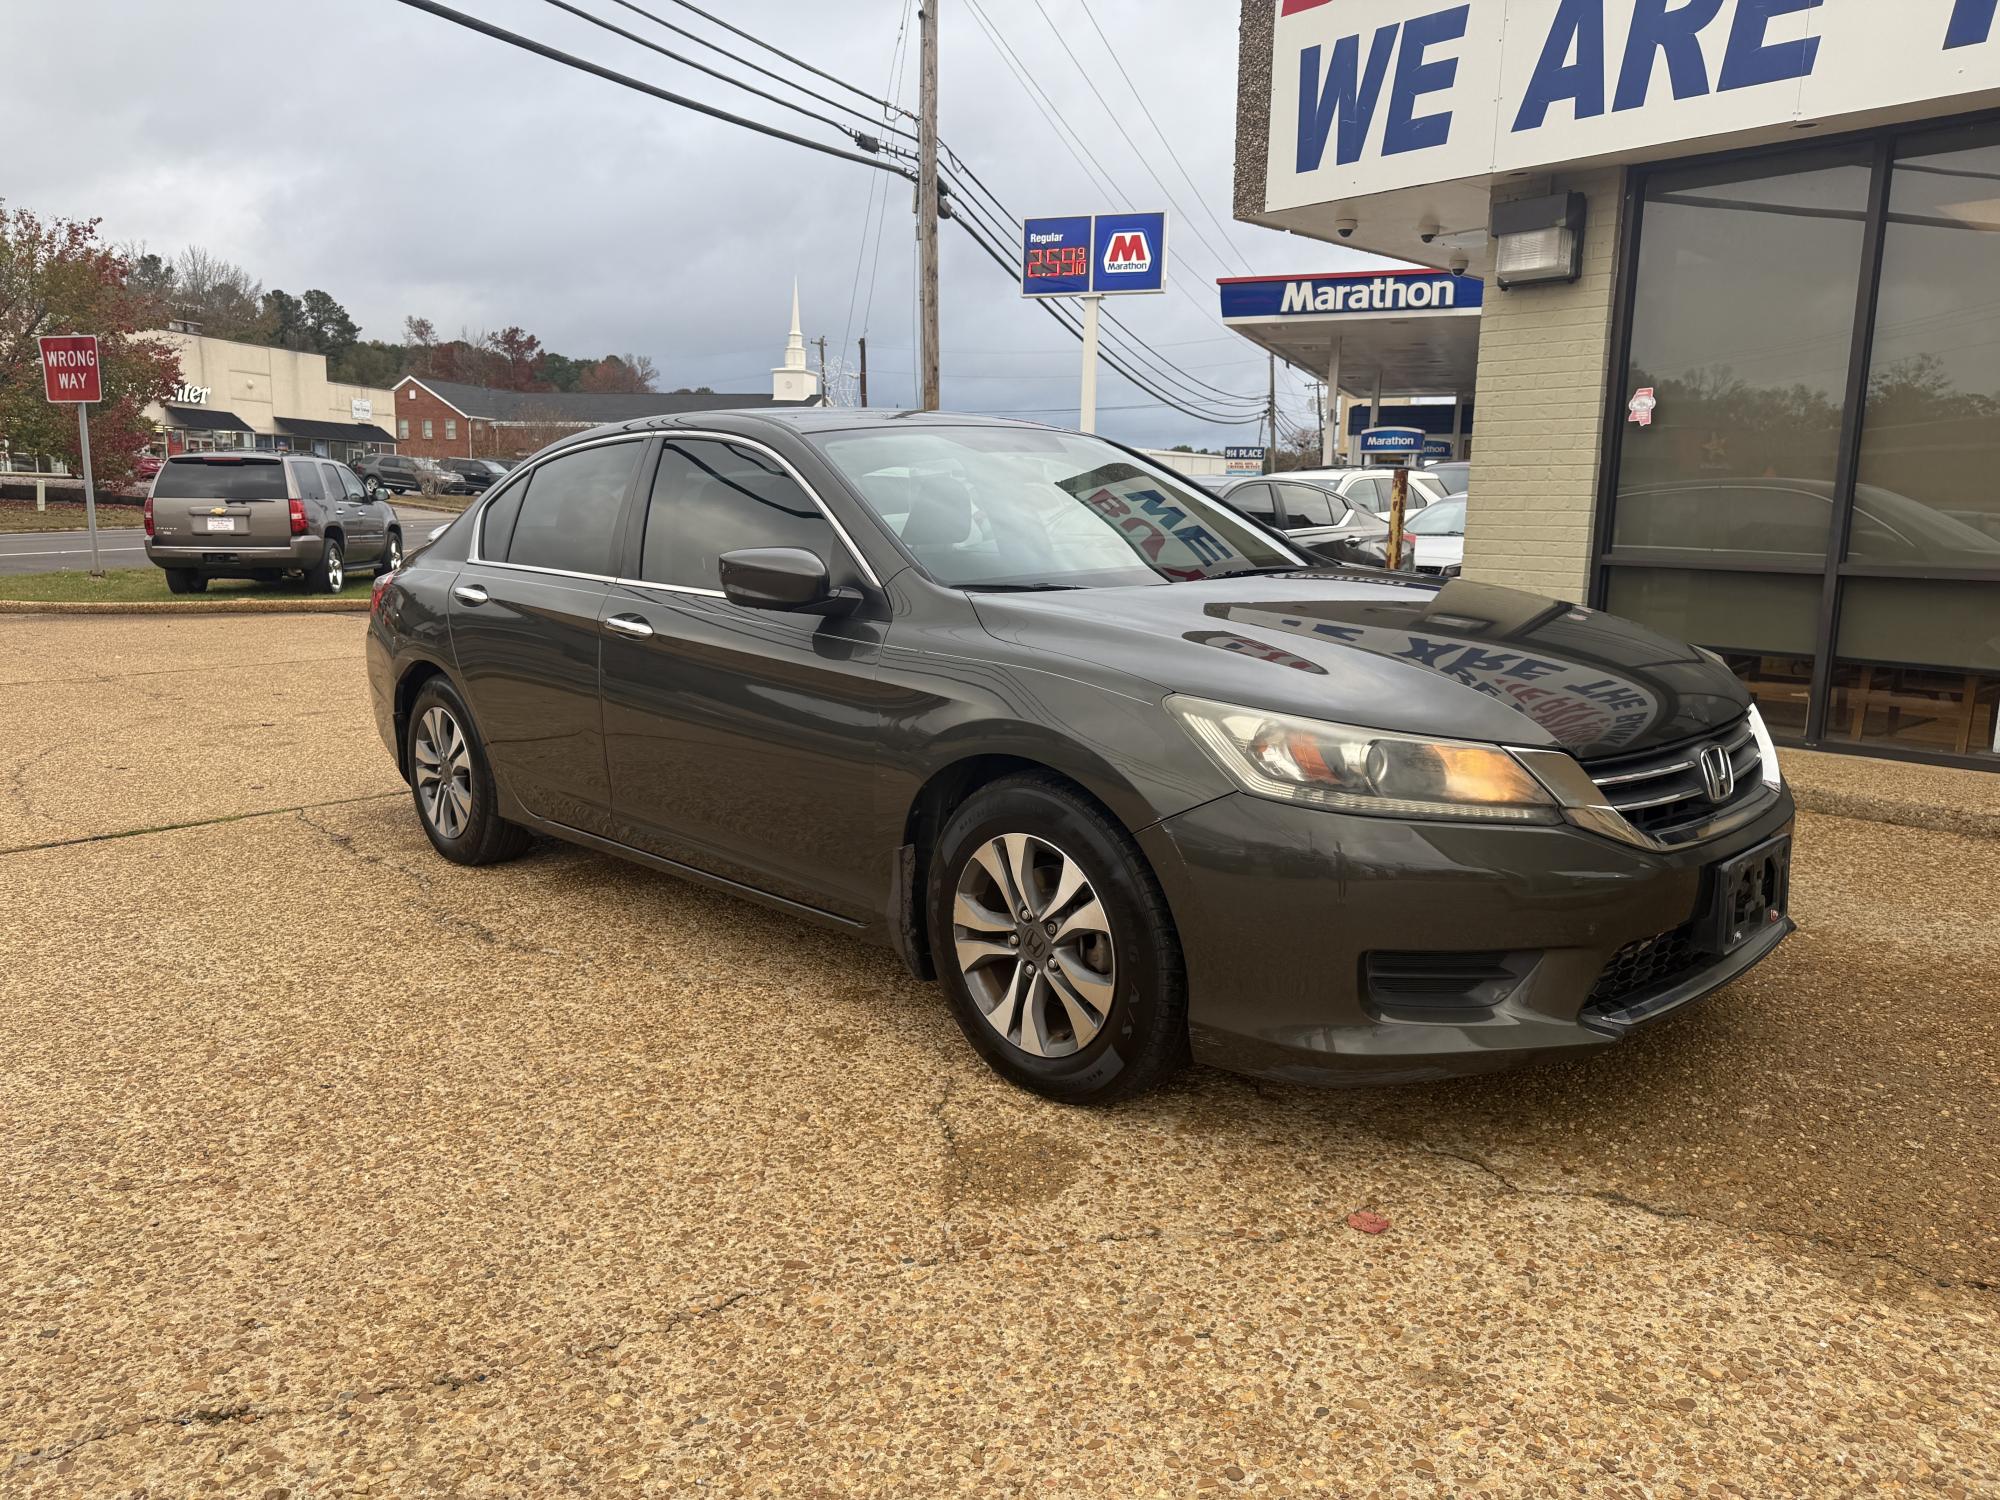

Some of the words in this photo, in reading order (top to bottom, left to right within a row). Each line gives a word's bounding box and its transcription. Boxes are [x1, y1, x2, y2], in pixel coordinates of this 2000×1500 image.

[1295, 3, 1470, 174] WE
[1511, 0, 1824, 133] ARE
[1030, 232, 1064, 245] Regular
[1027, 247, 1076, 278] 2.59
[1107, 262, 1147, 271] Marathon
[1280, 277, 1455, 313] Marathon
[46, 350, 95, 367] WRONG
[58, 372, 87, 390] WAY
[166, 382, 211, 404] nter
[1367, 436, 1414, 446] Marathon
[1239, 449, 1263, 458] PLACE
